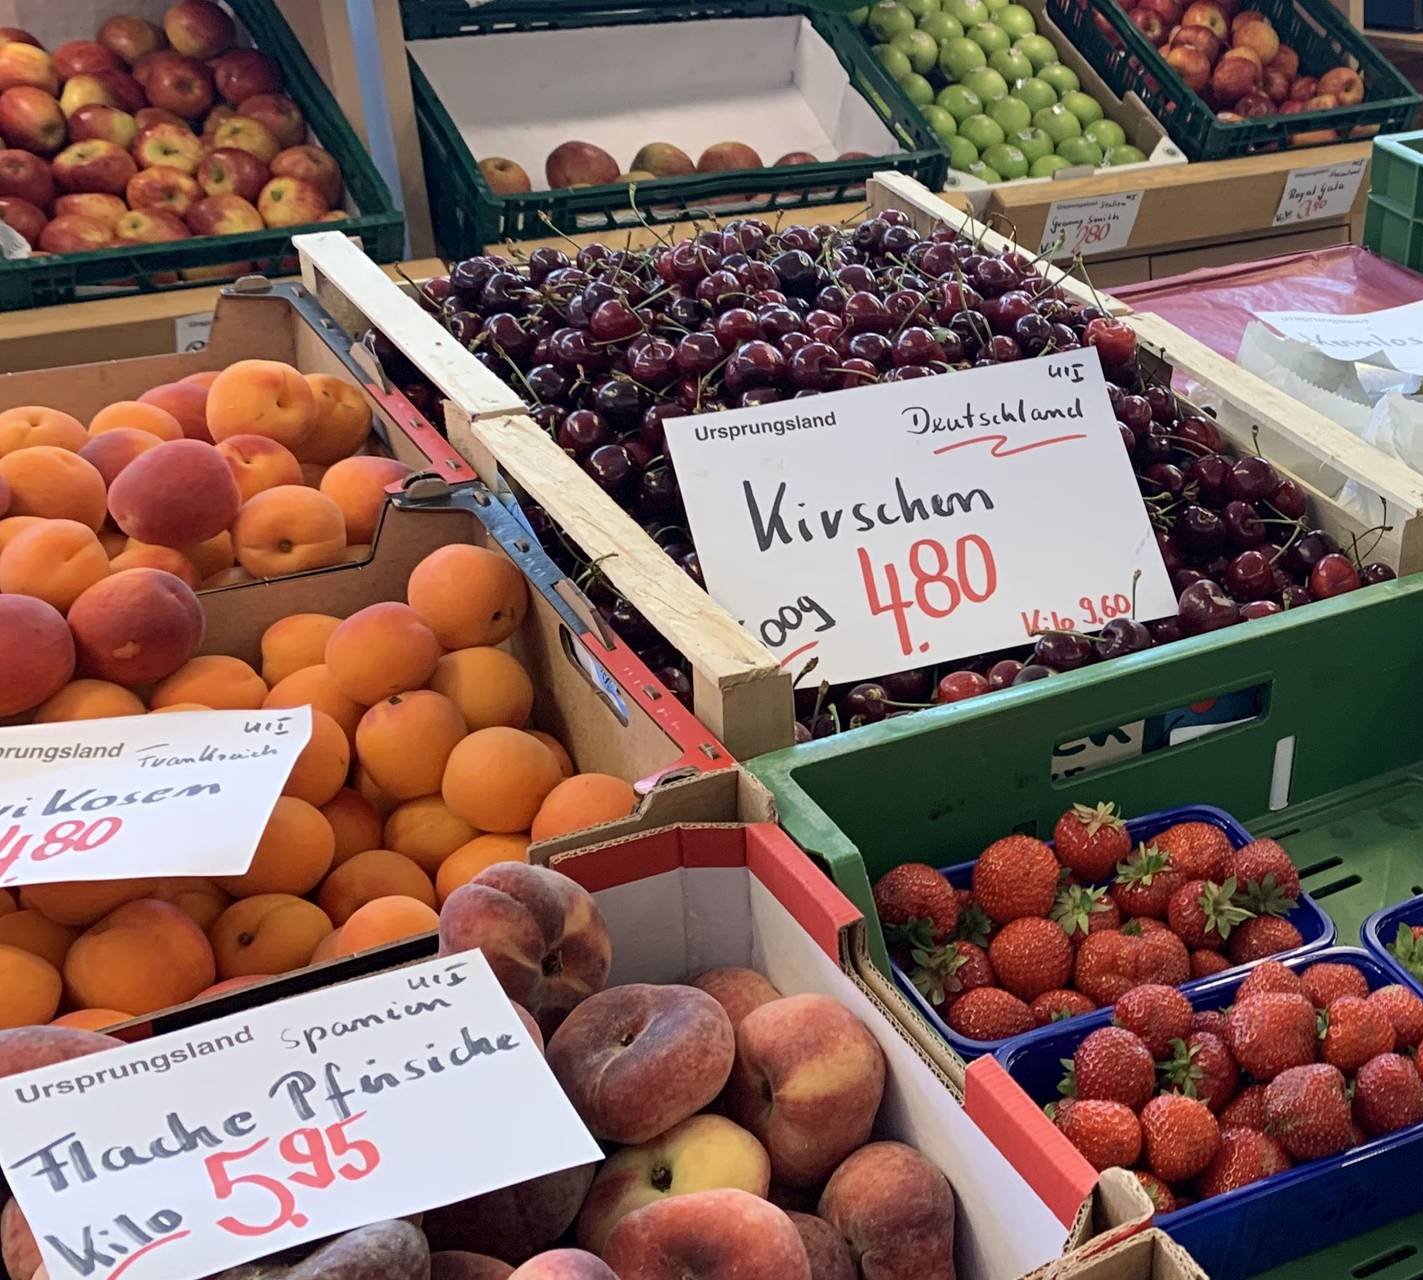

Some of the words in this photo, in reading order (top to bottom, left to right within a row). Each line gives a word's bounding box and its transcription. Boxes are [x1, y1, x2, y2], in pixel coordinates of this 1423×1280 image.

[695, 411, 837, 442] Ursprungsland
[902, 398, 1083, 436] Deutschland
[743, 477, 995, 553] Kirschen
[738, 595, 837, 649] 00g
[1021, 608, 1075, 638] Kilo
[15, 1024, 255, 1104] Ursprungsland
[281, 993, 454, 1056] Spanien
[9, 1110, 257, 1193] Flache
[268, 1025, 520, 1123] Pfirsiche
[44, 1208, 183, 1280] Kilo
